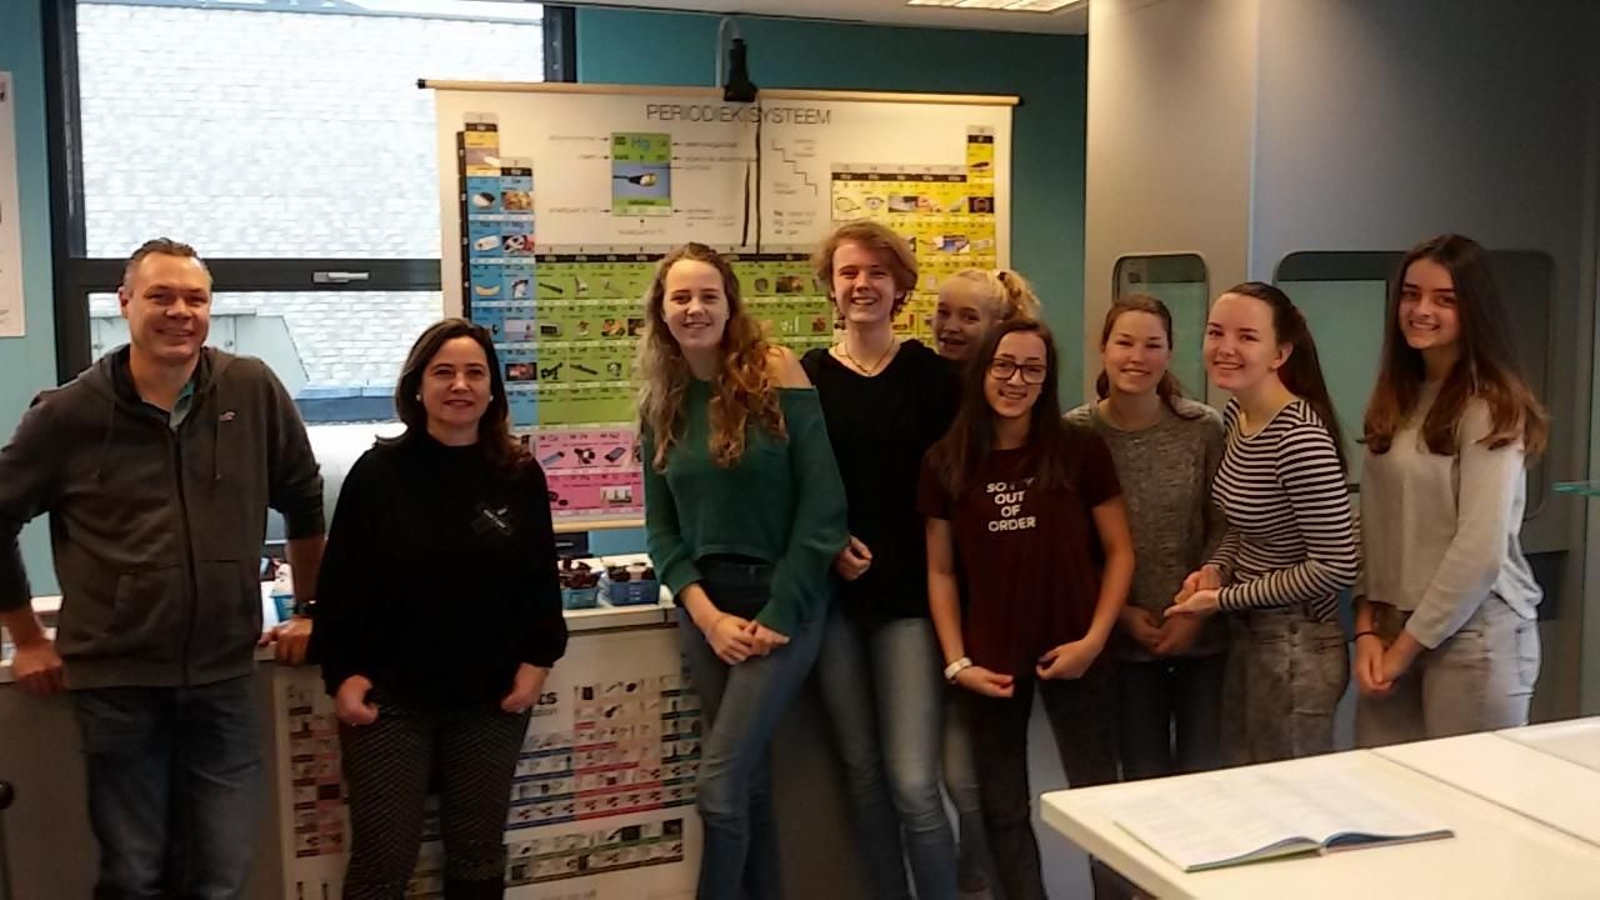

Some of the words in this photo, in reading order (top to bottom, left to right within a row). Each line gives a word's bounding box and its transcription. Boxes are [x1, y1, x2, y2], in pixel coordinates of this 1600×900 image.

[646, 104, 742, 122] PERIODIEK
[749, 106, 831, 125] SYSTEEM
[631, 136, 651, 152] Hg
[986, 477, 1035, 493] SOY
[994, 490, 1025, 505] OUT
[1000, 504, 1021, 518] OF
[988, 516, 1036, 532] ORDER
